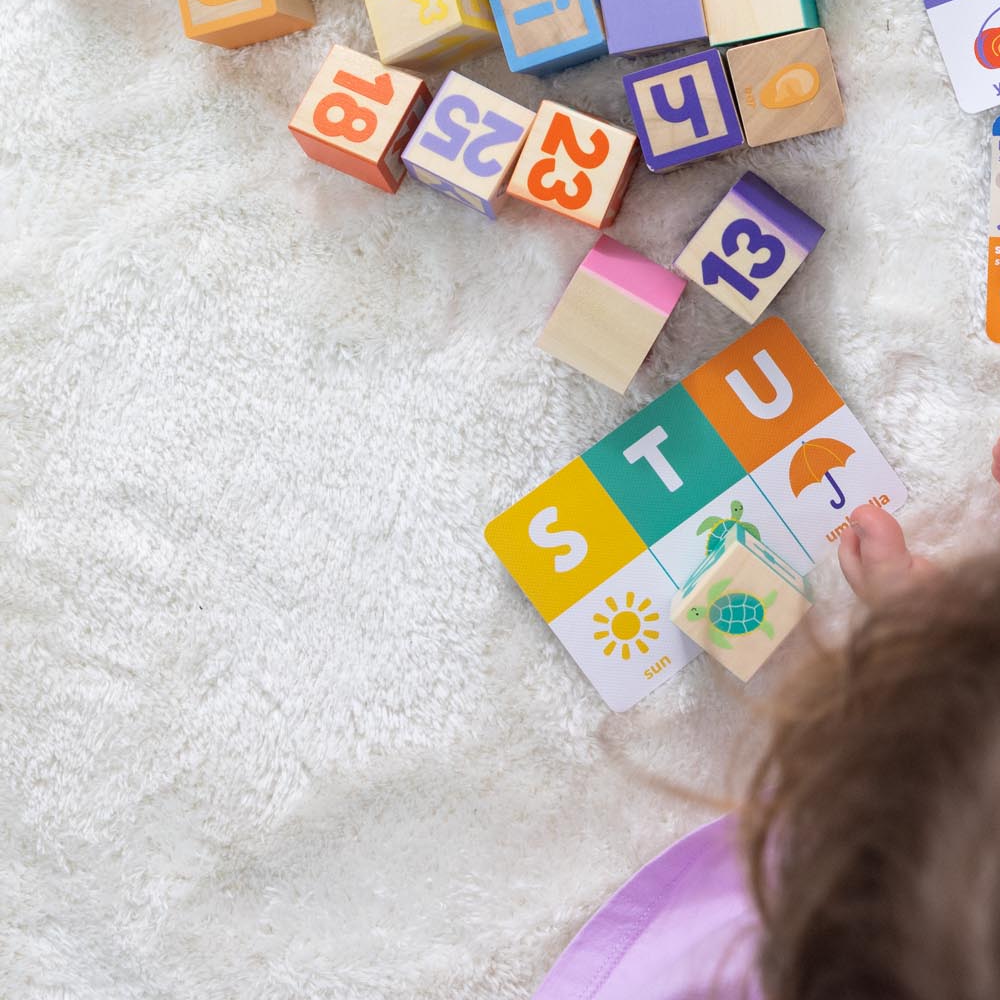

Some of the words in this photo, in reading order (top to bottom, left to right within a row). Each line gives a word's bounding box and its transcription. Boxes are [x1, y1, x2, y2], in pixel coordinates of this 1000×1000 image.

[312, 69, 395, 143] 18
[418, 93, 525, 178] 25
[527, 112, 610, 211] 23
[702, 218, 786, 301] 13
[528, 506, 588, 574] S
[622, 425, 684, 493] T
[724, 349, 794, 420] U
[642, 654, 672, 681] sun
